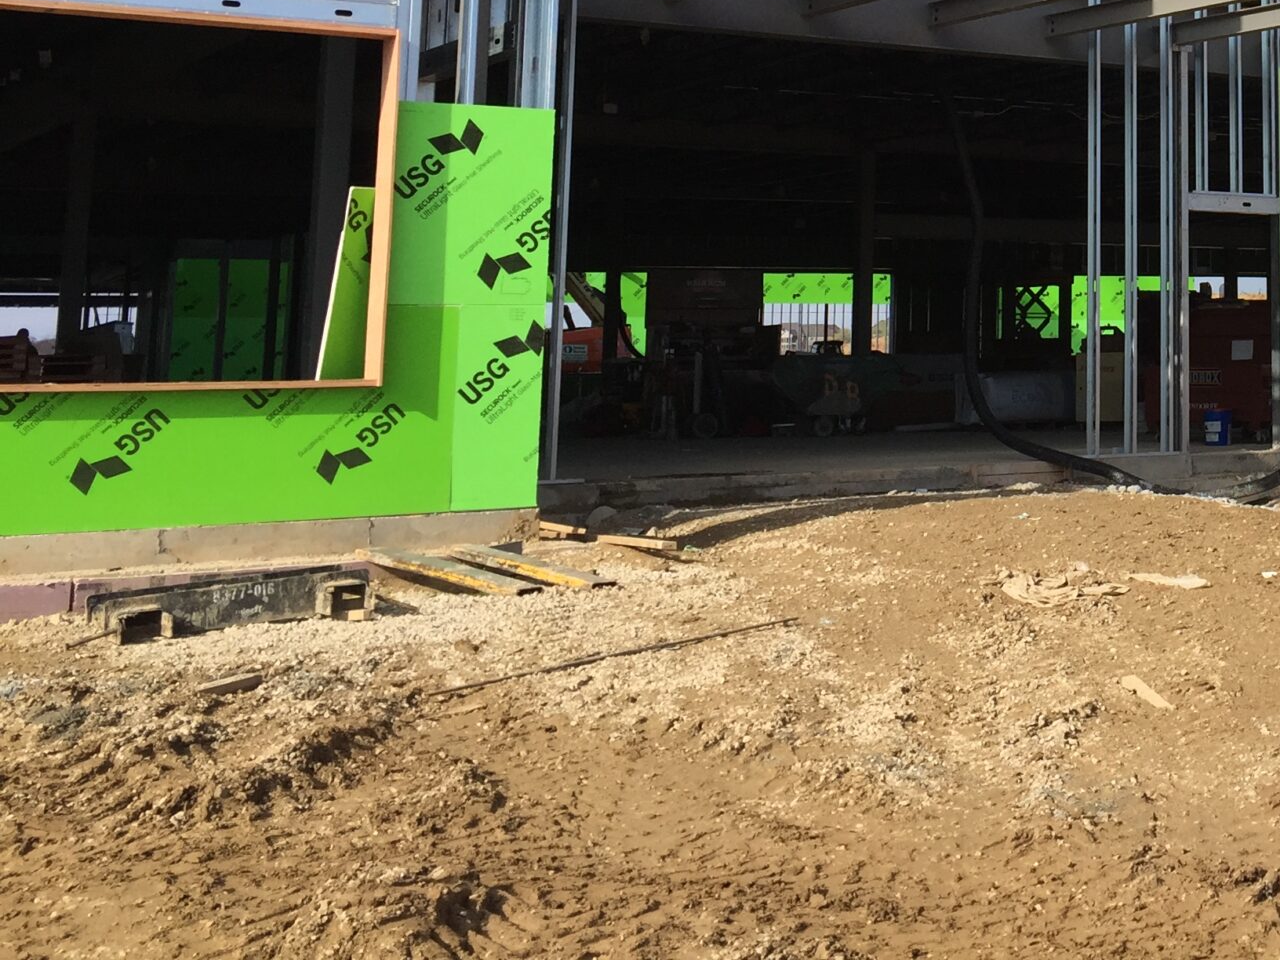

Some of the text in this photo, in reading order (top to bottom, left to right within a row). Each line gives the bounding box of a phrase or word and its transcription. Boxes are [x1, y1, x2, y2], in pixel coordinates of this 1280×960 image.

[393, 154, 446, 200] USG
[457, 358, 510, 405] USG
[113, 408, 171, 456] USG
[355, 403, 406, 448] USG
